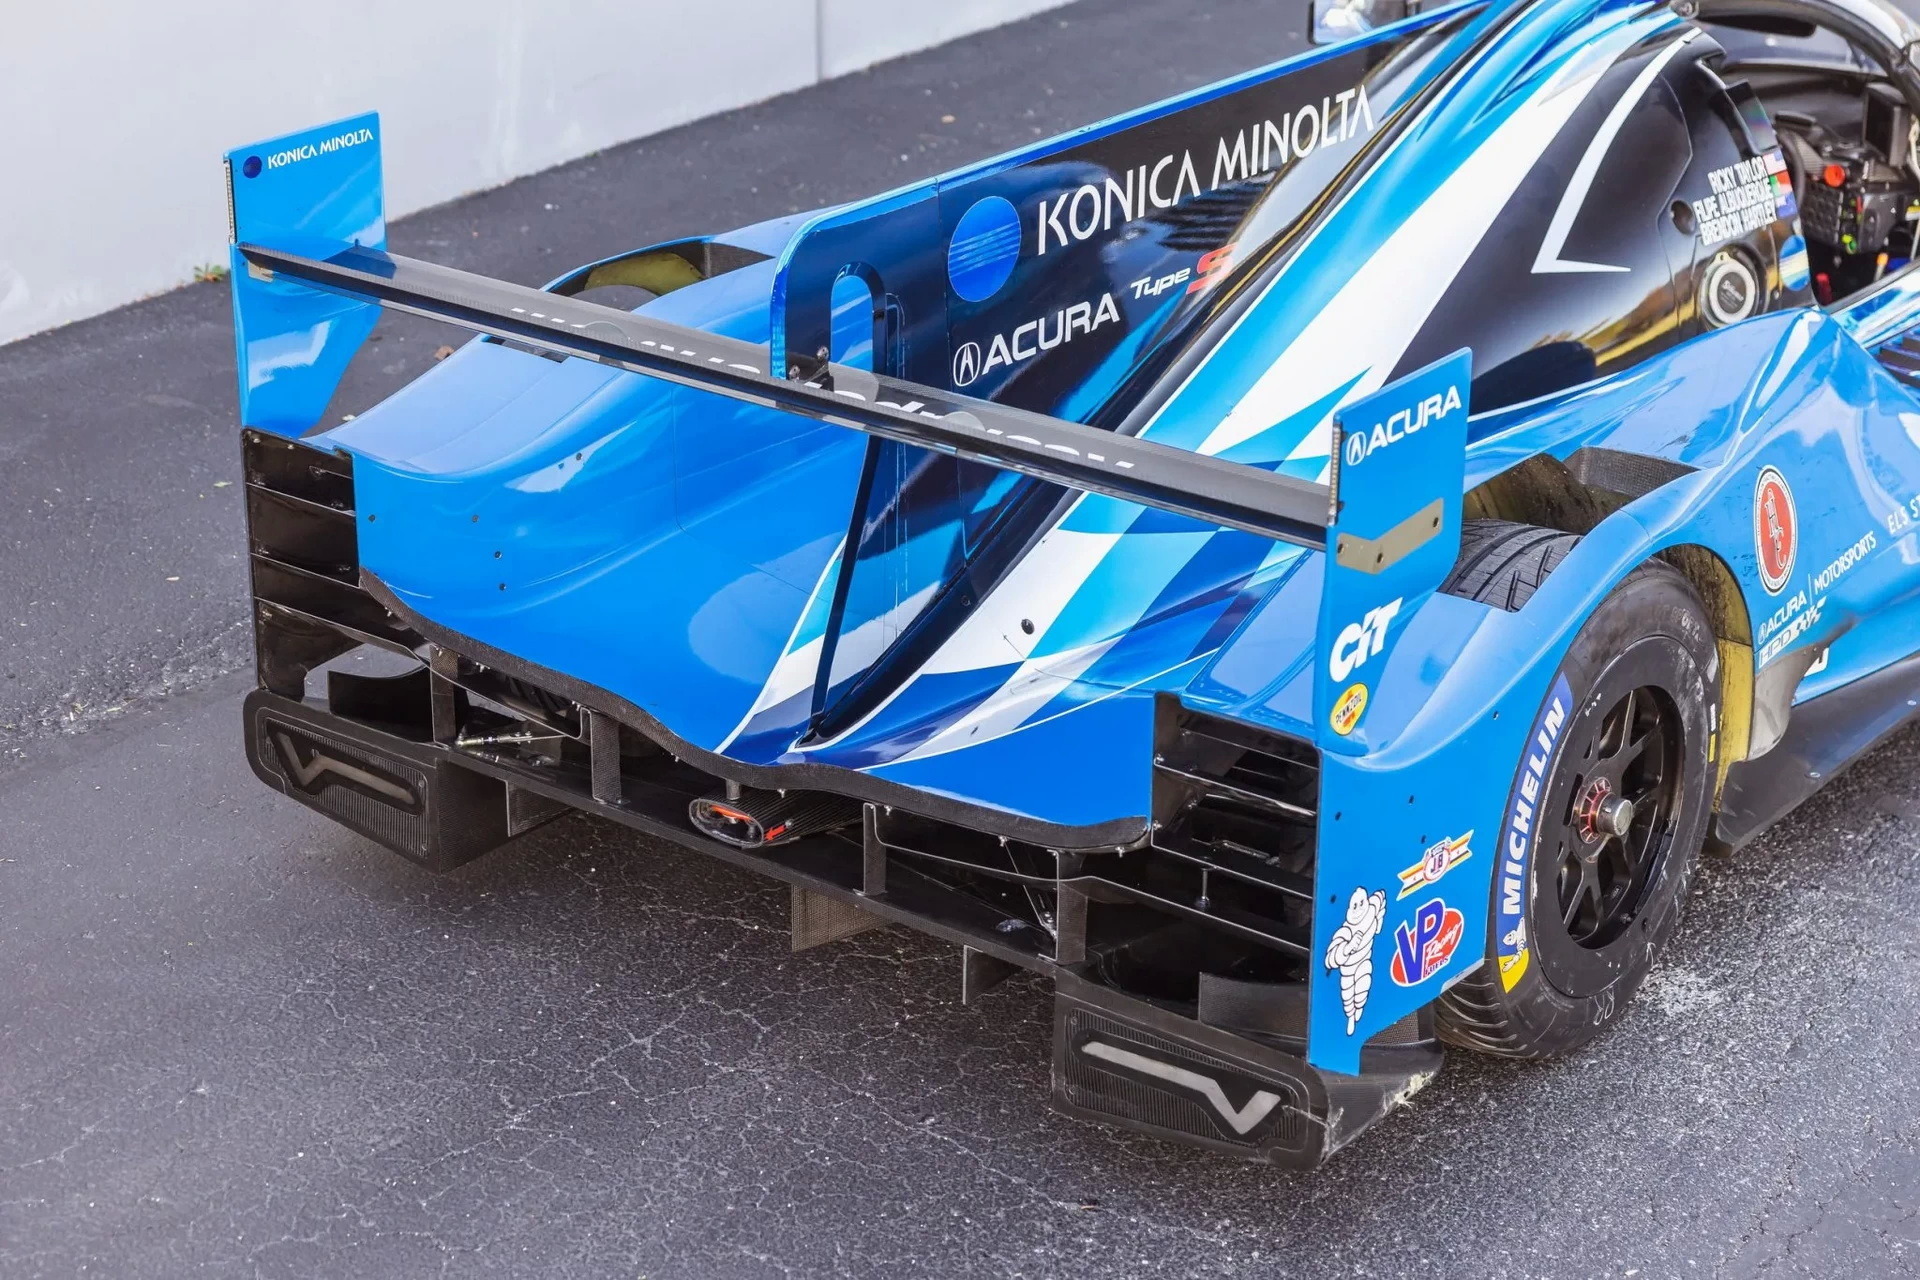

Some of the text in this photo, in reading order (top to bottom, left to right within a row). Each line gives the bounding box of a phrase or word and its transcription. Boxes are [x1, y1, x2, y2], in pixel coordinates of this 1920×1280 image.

[267, 128, 373, 169] KONICA MINOLTA
[1038, 84, 1374, 255] KONICA MINOLTA
[1733, 156, 1768, 186] TAYLOR
[1700, 199, 1777, 246] BRENDON HARTLEY
[1130, 242, 1237, 300] Type S
[981, 292, 1121, 376] ACURA
[1366, 385, 1462, 457] ACURA
[1887, 505, 1909, 535] ELS
[1766, 590, 1807, 638] ACURA
[1814, 530, 1877, 595] MOTORSPORTS
[1760, 629, 1792, 667] HPD
[1335, 691, 1363, 724] PENNZOIL
[1502, 696, 1567, 916] MICHELIN
[1396, 899, 1445, 984] VP
[1424, 921, 1463, 966] Racing
